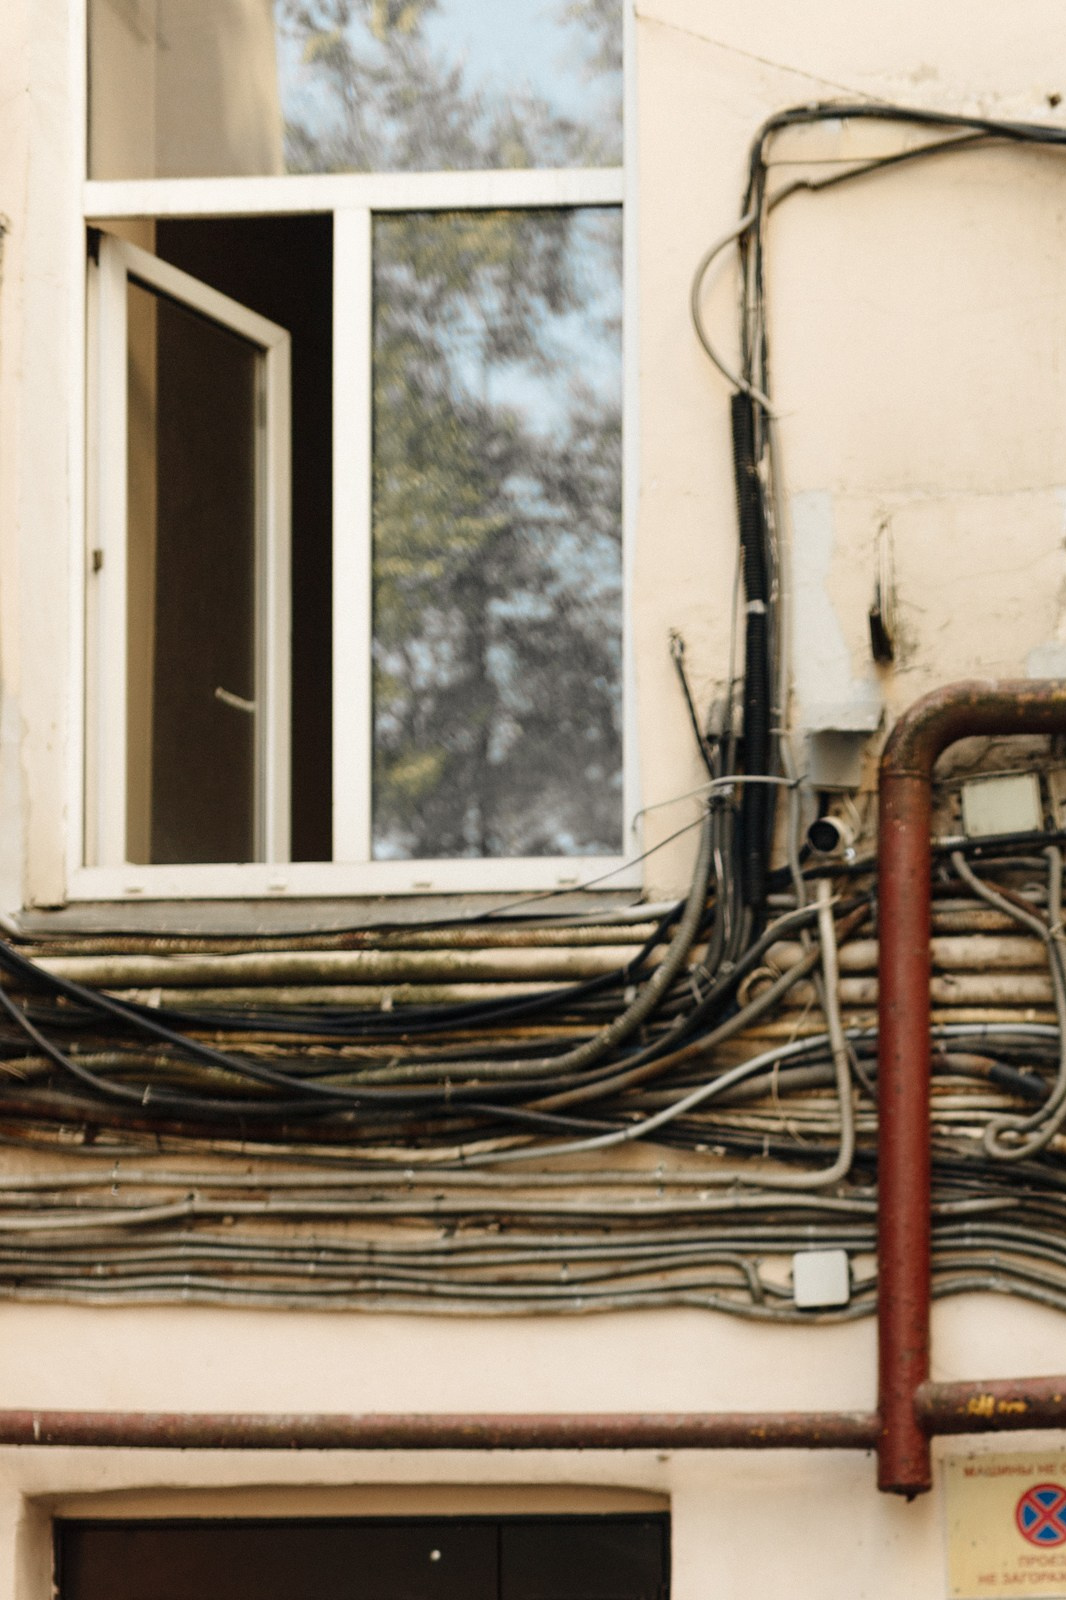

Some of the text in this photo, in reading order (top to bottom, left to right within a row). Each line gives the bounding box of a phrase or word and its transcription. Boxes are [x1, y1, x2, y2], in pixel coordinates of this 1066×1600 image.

[963, 1463, 1033, 1477] МАШИНЫ
[1037, 1462, 1054, 1474] НЕ
[978, 1573, 996, 1585] НЕ
